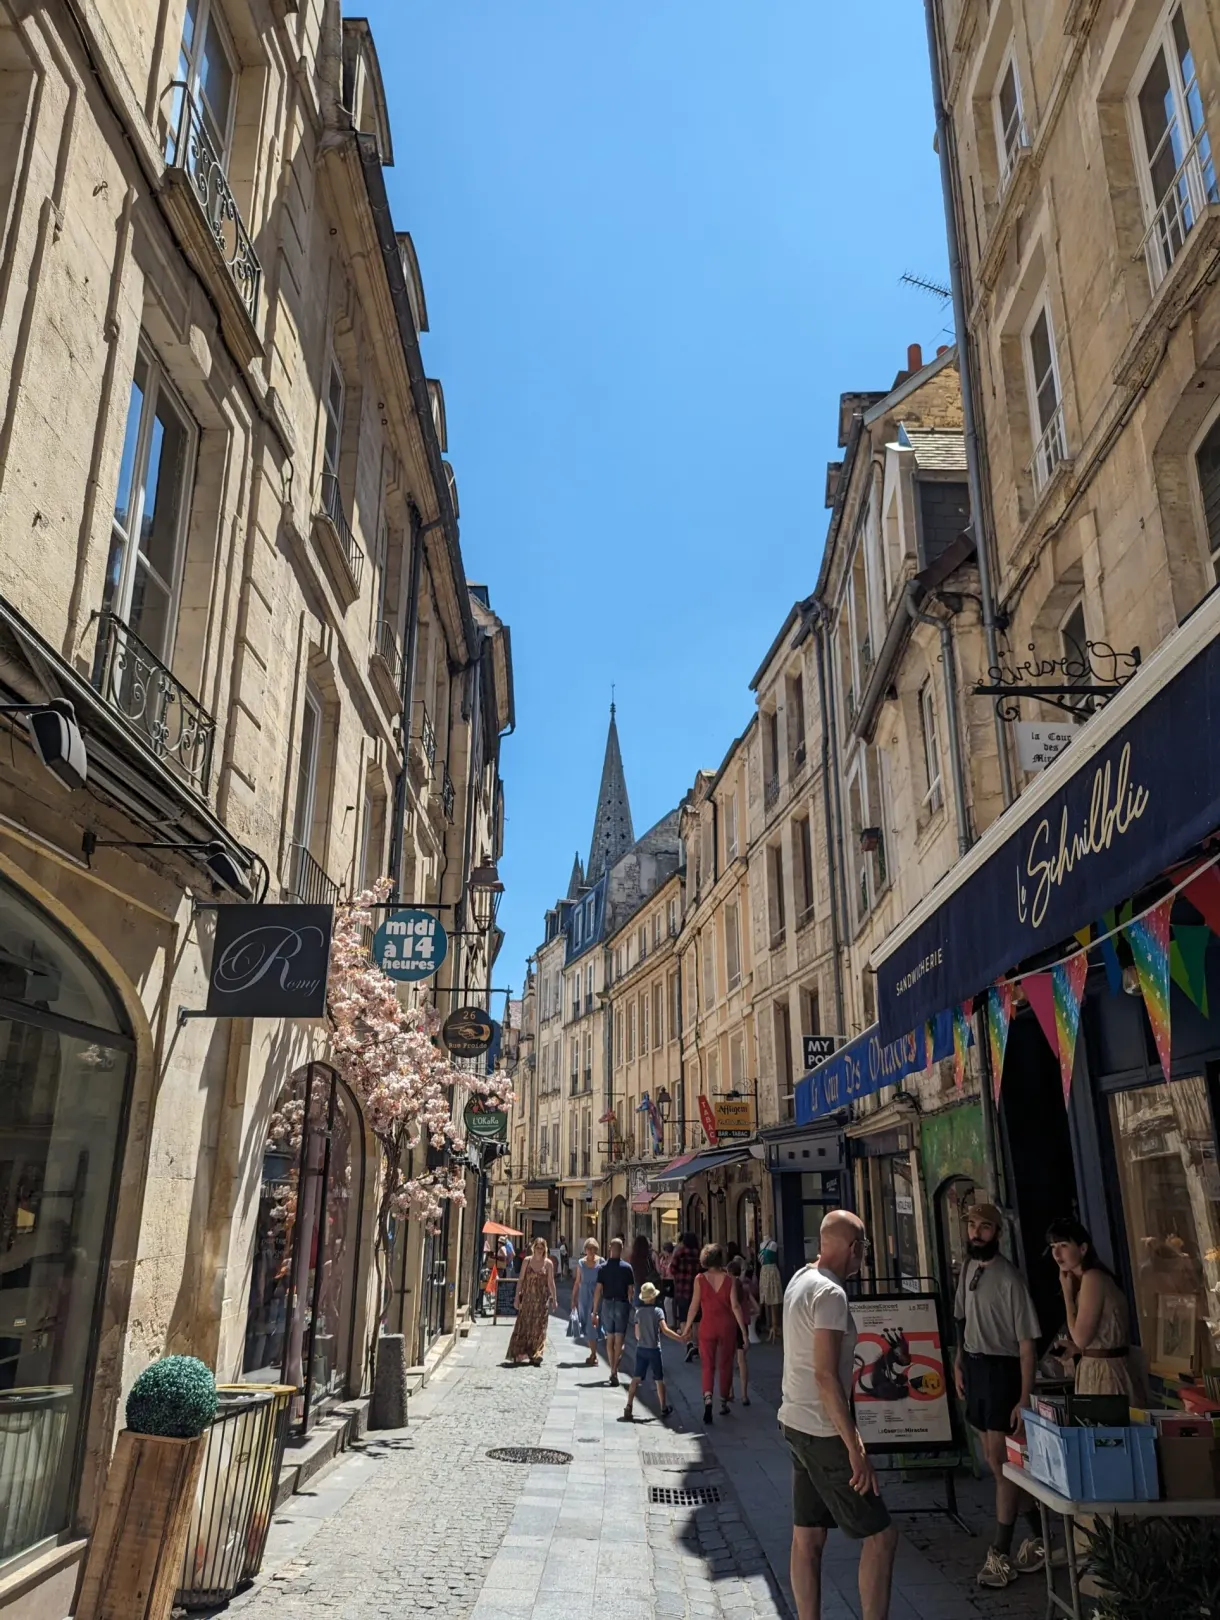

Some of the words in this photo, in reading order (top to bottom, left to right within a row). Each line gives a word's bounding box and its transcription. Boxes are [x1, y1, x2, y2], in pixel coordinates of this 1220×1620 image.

[1048, 732, 1072, 741] Cour
[1043, 743, 1059, 751] des
[385, 918, 436, 936] midi
[384, 940, 397, 958] à
[402, 936, 435, 959] 14
[213, 925, 324, 997] Romy
[382, 957, 435, 970] heures
[896, 947, 943, 997] SANDWICHERIE
[462, 1010, 477, 1020] 26
[807, 1040, 830, 1052] MY
[701, 1101, 715, 1138] TABAC
